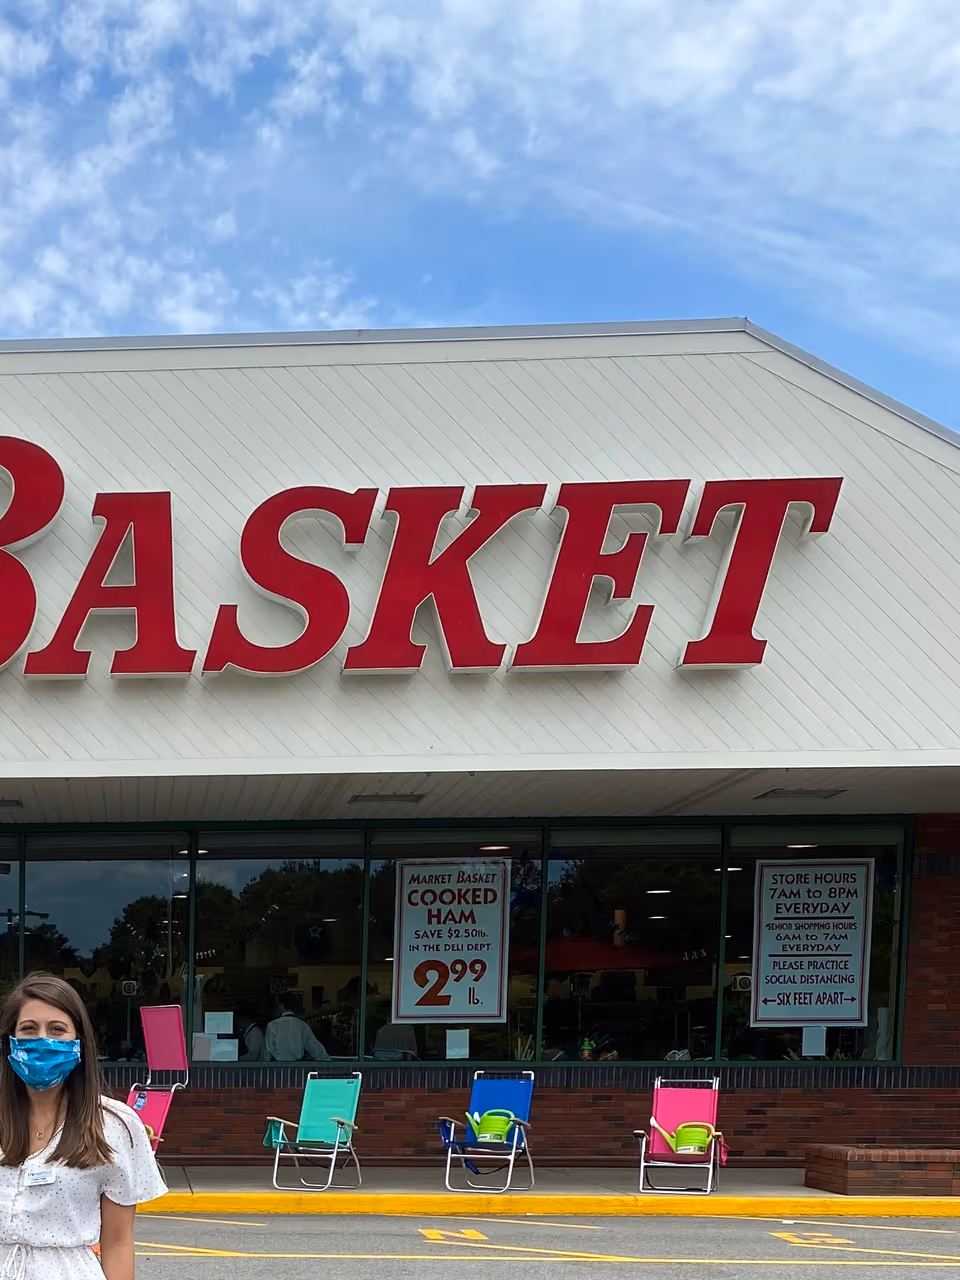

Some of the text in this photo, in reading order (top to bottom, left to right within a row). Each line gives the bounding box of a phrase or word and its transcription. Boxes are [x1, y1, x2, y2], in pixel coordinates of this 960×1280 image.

[408, 870, 498, 885] MARKET BASKET
[772, 872, 857, 885] STORE HOURS
[407, 888, 498, 907] COOKED
[769, 887, 859, 900] 7AM to 8PM
[775, 902, 851, 914] EVERYDAY
[427, 908, 477, 926] HAM
[794, 922, 831, 931] SHOPPING
[832, 922, 858, 931] HOURS
[414, 929, 443, 939] SAVE
[775, 933, 849, 941] 6AM to 7AM
[408, 944, 420, 952] IN
[422, 944, 441, 952] THE
[444, 943, 464, 952] DELI
[781, 943, 841, 952] EVERYDAY
[772, 960, 849, 970] PLEASE PRACTICE
[765, 974, 856, 985] SOCIAL DISTANCING
[776, 991, 844, 1005] SIX FEET APART
